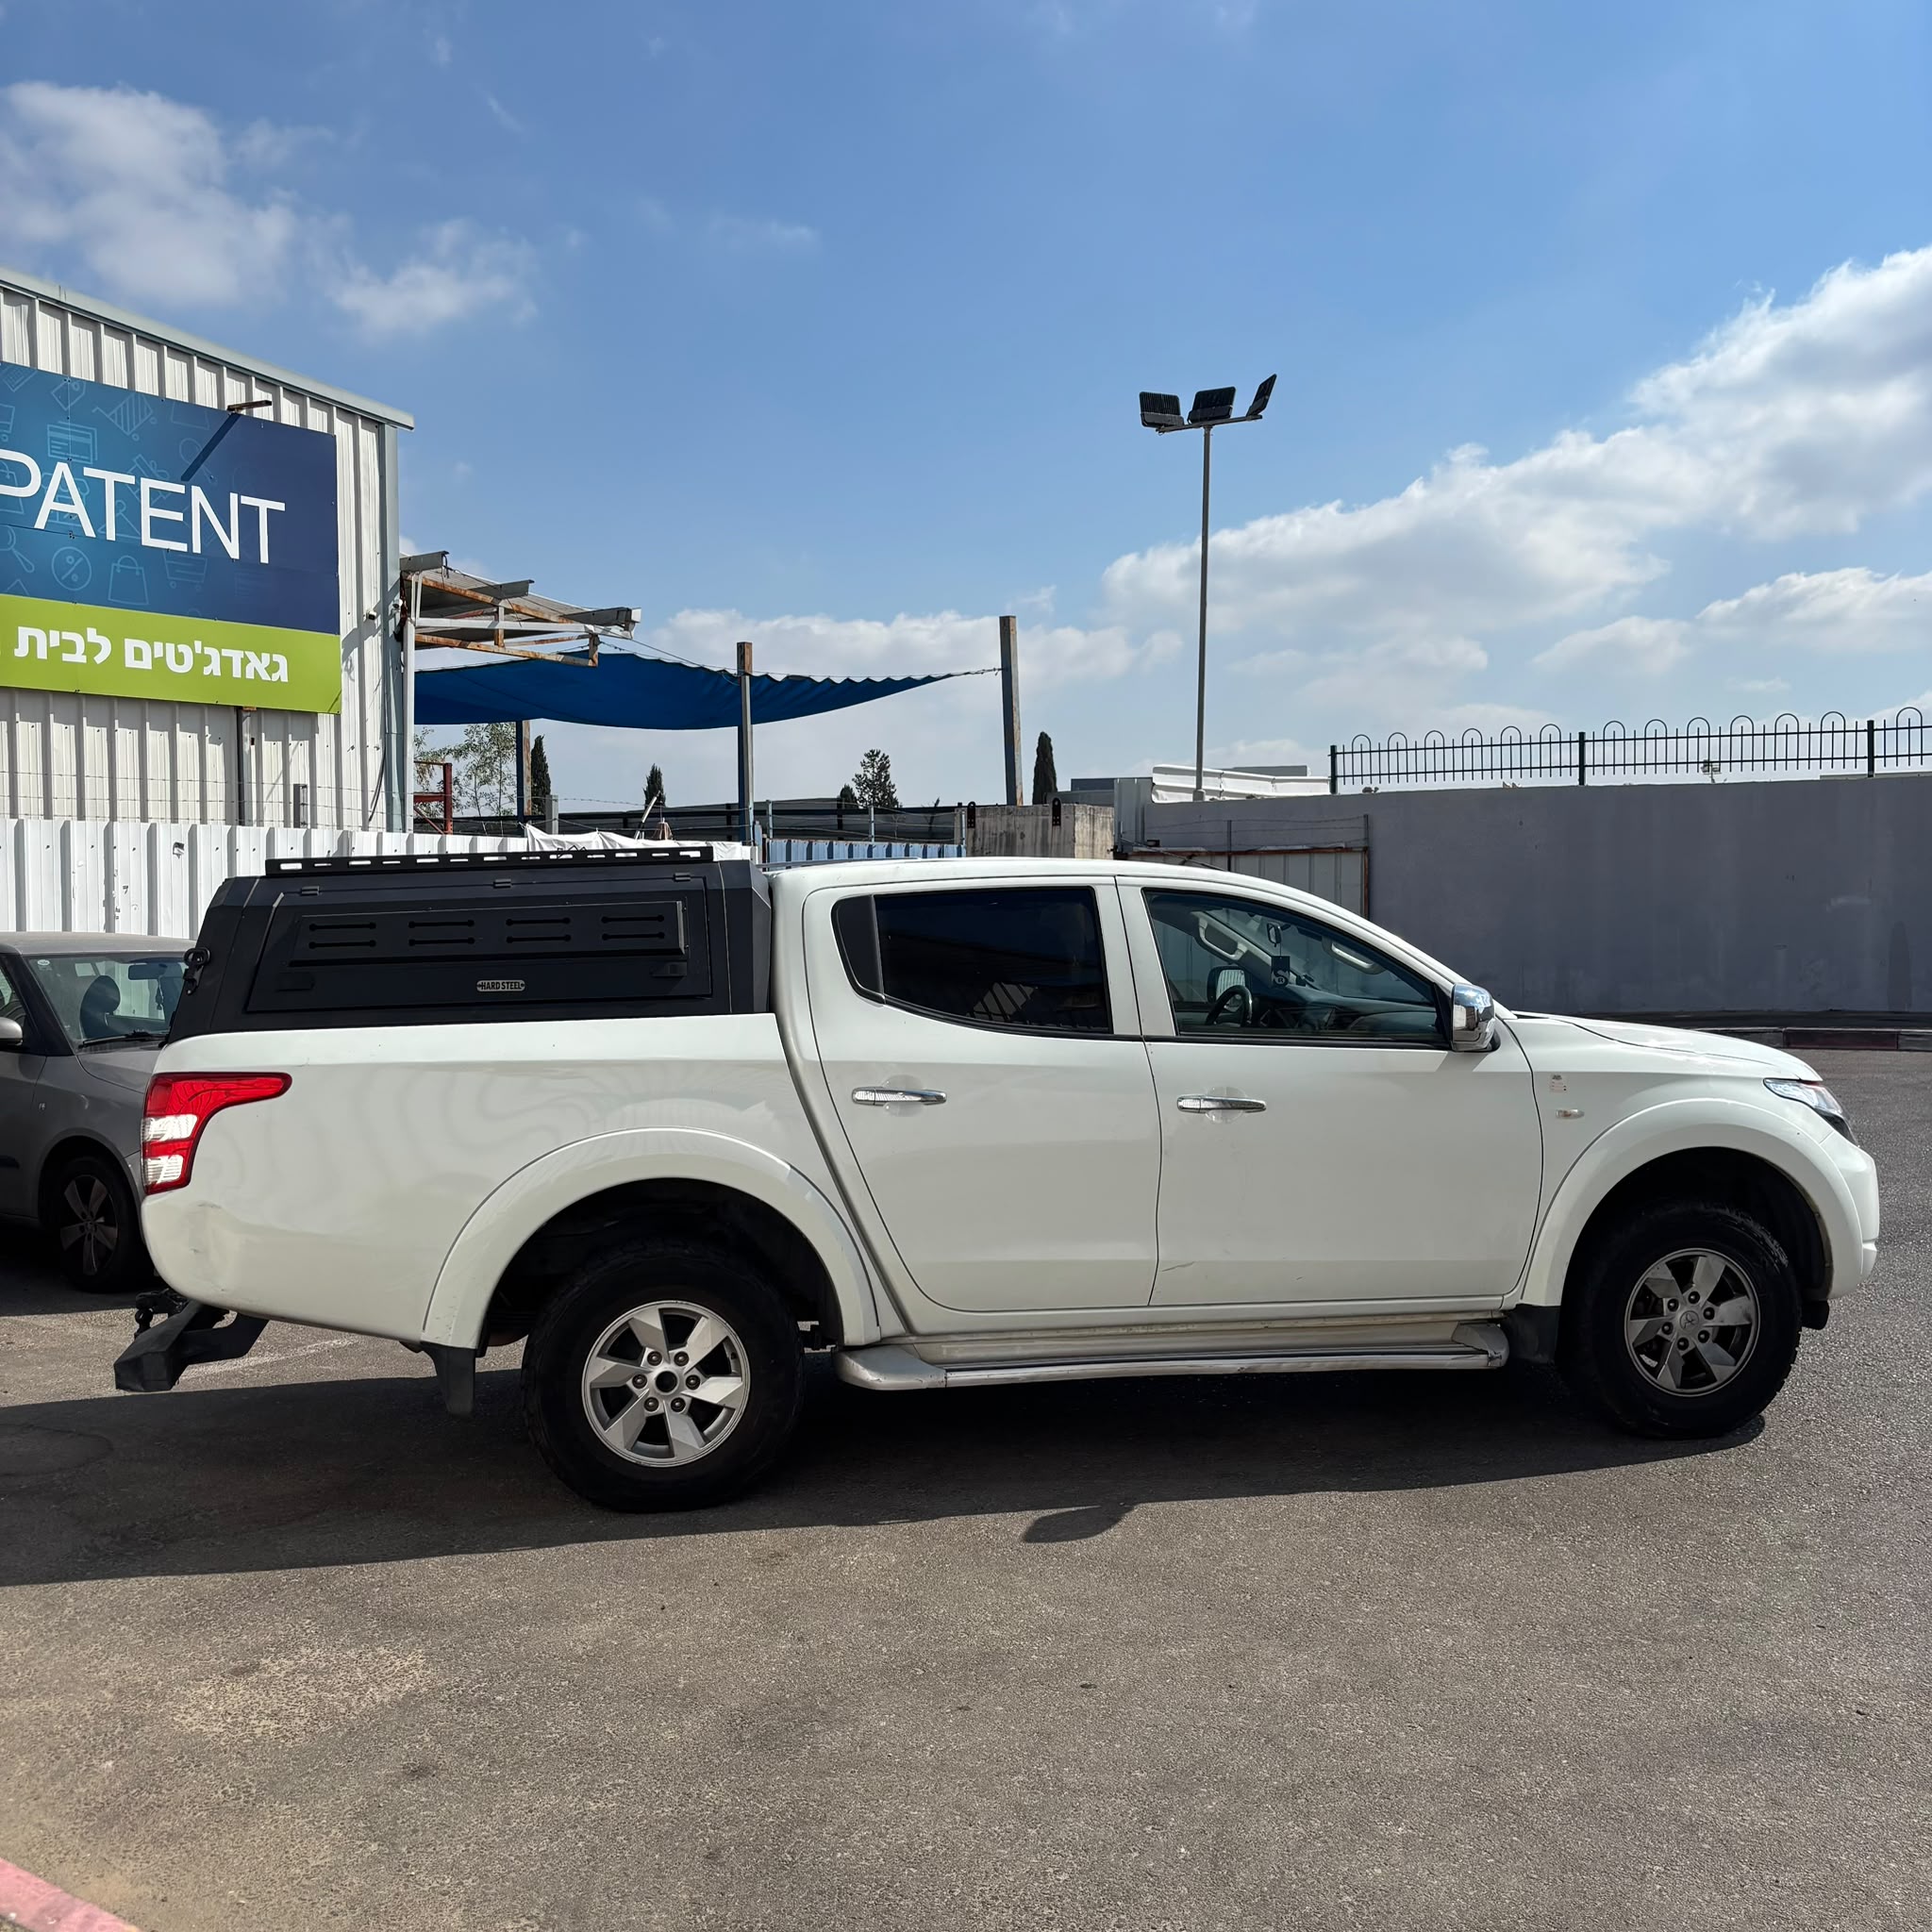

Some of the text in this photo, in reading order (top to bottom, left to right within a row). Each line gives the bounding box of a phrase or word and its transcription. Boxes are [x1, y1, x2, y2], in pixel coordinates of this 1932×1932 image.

[0, 449, 286, 564] PATENT
[14, 626, 289, 683] גאדג'טים לבית
[480, 980, 522, 991] HARD STEEL
